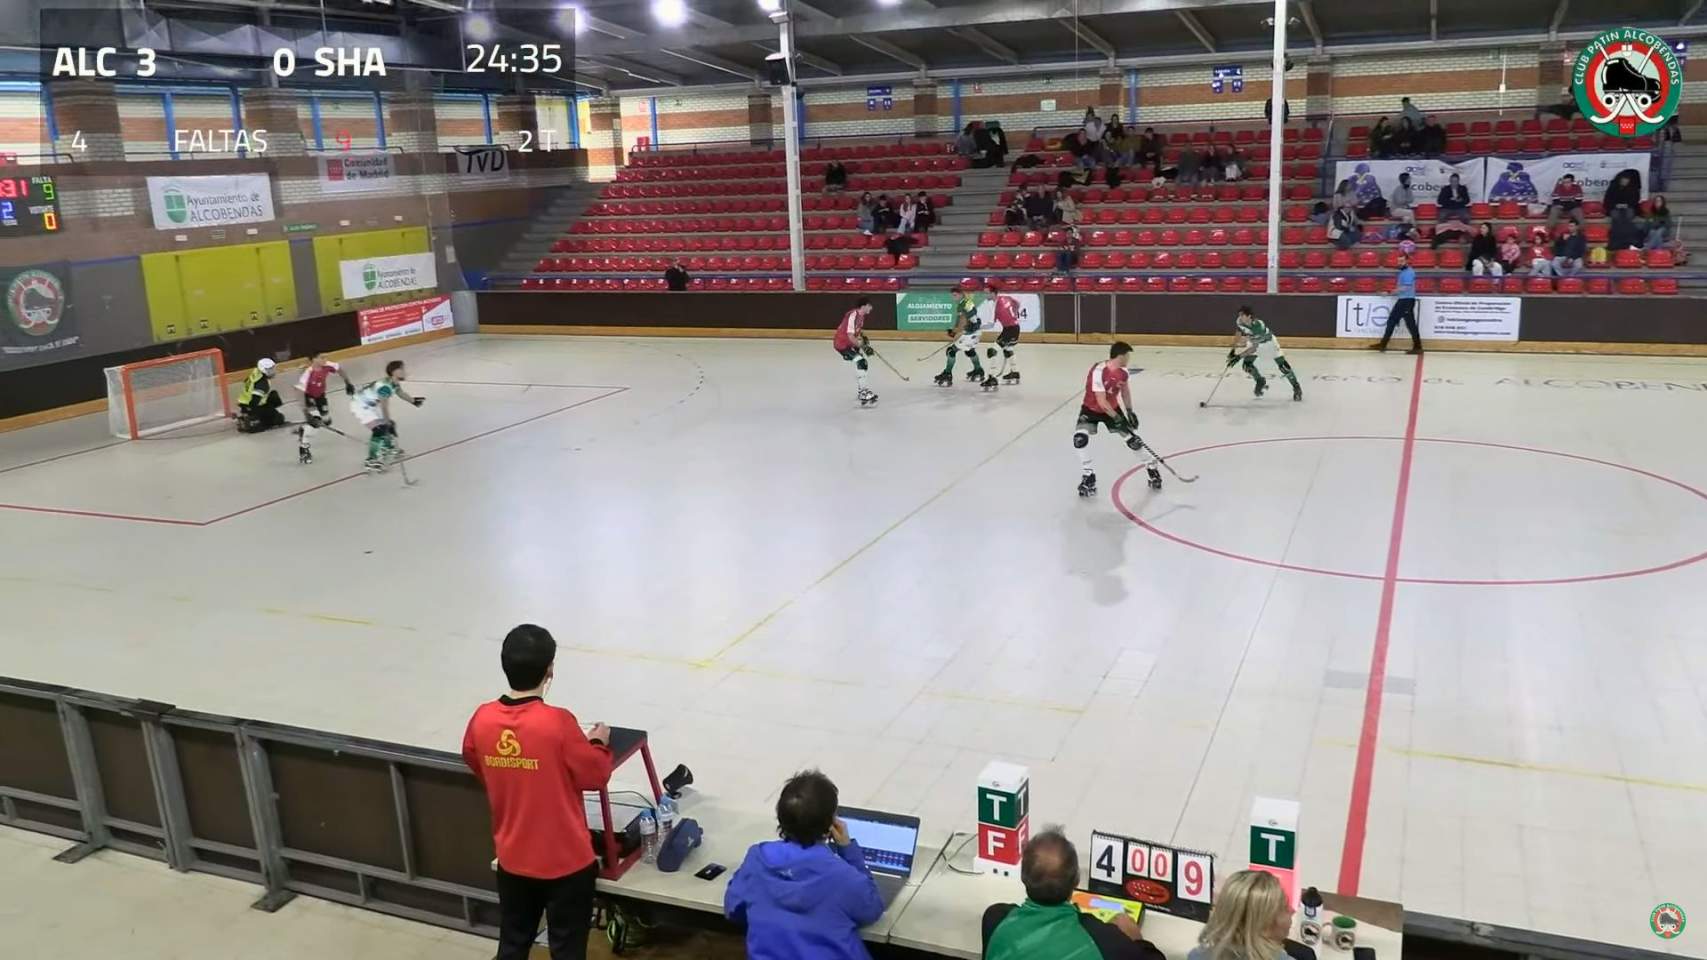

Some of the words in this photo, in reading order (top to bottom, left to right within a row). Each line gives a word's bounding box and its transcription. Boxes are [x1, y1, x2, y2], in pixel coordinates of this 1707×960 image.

[344, 156, 388, 169] Comunidad
[454, 144, 505, 174] TVD
[346, 170, 358, 180] de
[359, 168, 389, 180] Madrid
[43, 183, 55, 200] 9
[187, 193, 247, 208] Ayuntamiento
[251, 192, 260, 202] de
[1, 201, 14, 219] 2
[190, 205, 263, 223] ALCOBENDAS
[44, 212, 57, 230] 0
[986, 793, 1007, 821] T
[987, 830, 1006, 856] F
[1260, 832, 1286, 862] T
[1095, 844, 1116, 878] 4
[1184, 860, 1204, 896] 9
